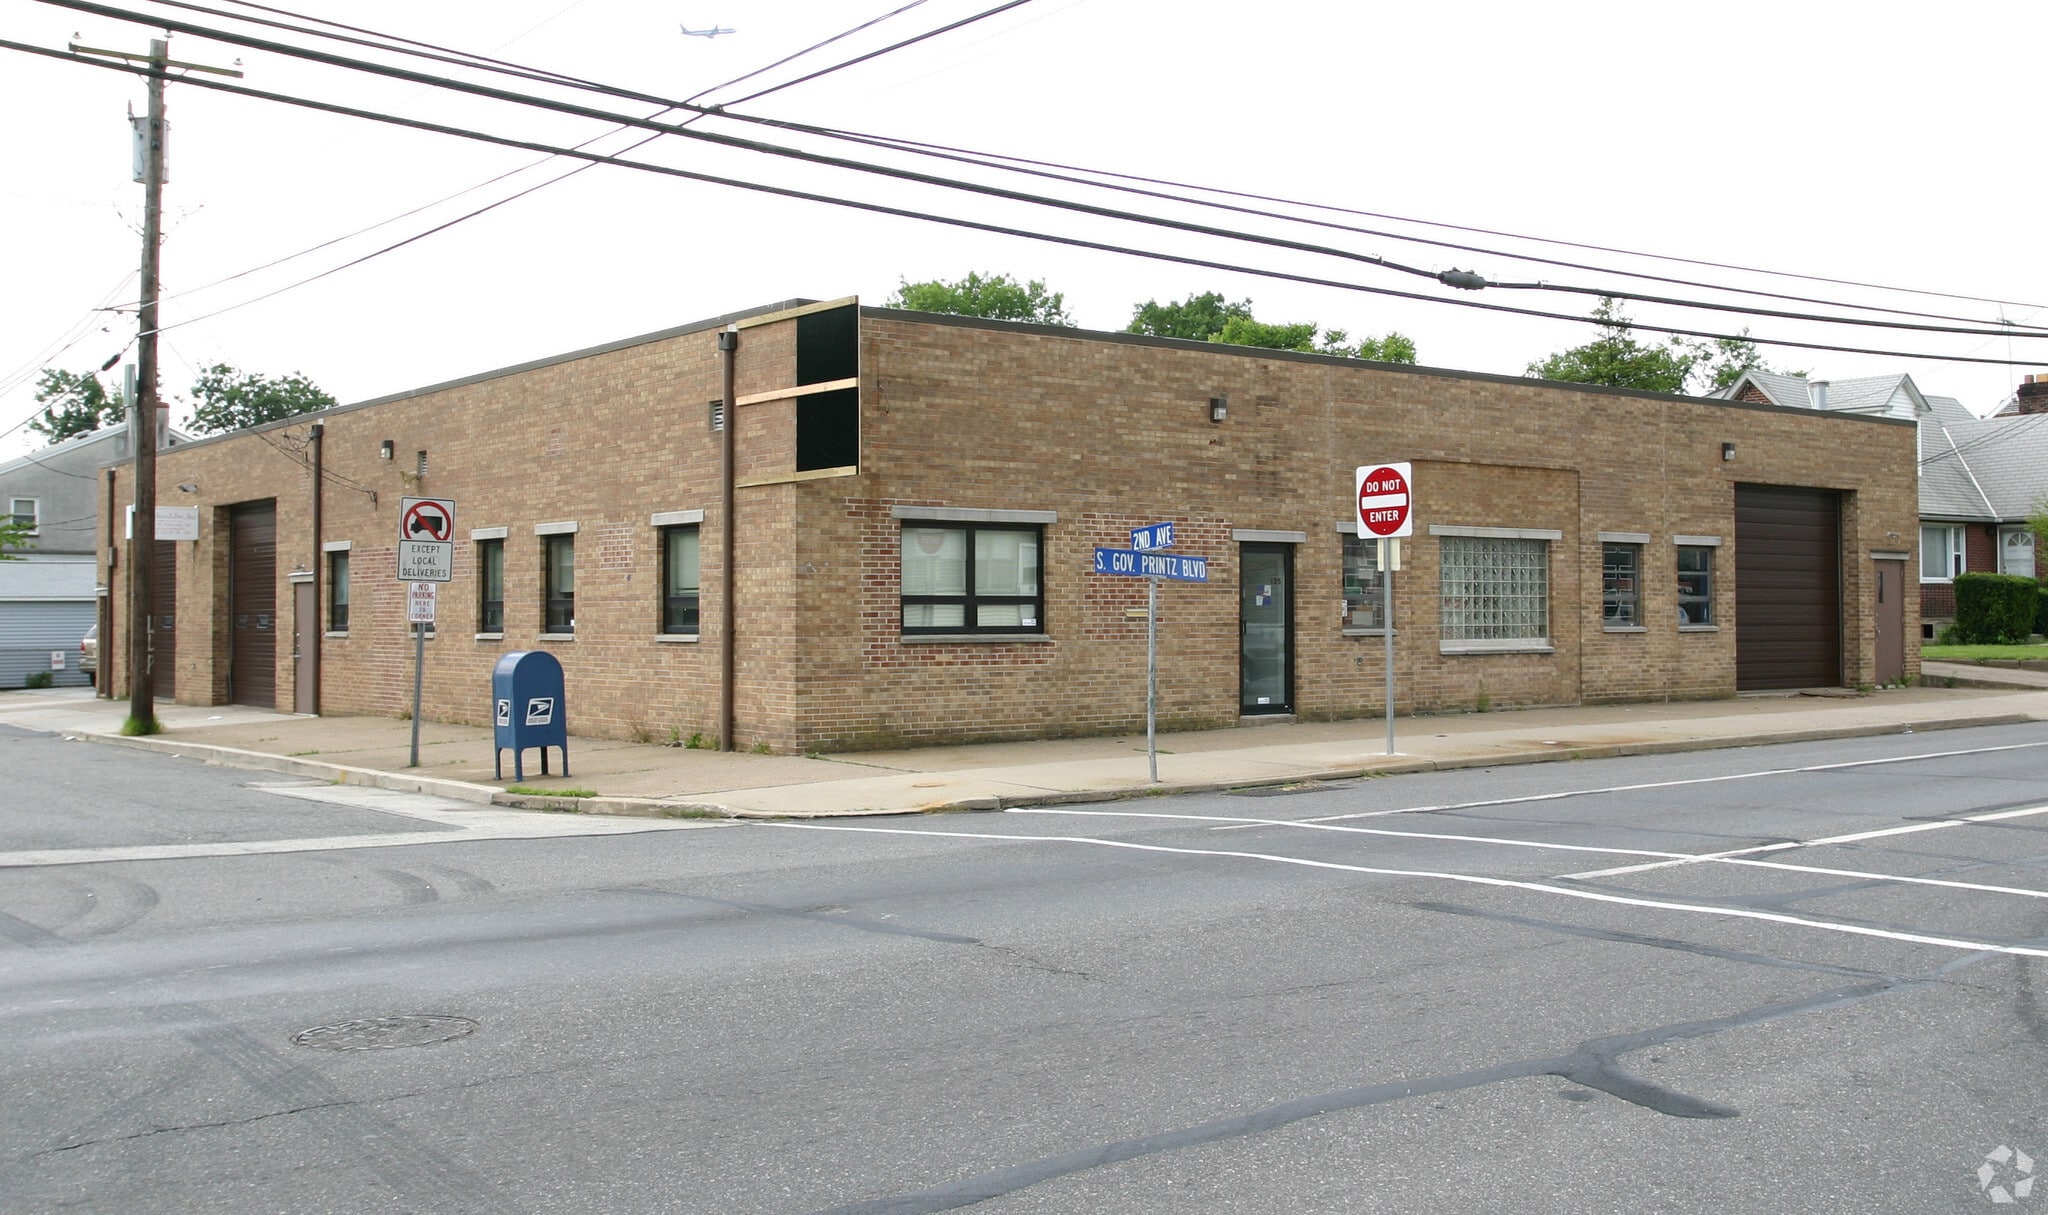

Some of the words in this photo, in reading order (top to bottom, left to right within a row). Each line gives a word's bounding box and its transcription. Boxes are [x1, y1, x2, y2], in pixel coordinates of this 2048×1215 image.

[1366, 481, 1379, 493] DO
[1382, 479, 1401, 491] NOT
[1370, 510, 1399, 523] ENTER
[1133, 531, 1150, 551] 2ND
[1156, 526, 1172, 546] AVE
[411, 545, 440, 553] EXCEPT
[412, 557, 437, 566] LOCAL
[1096, 552, 1106, 570] S.
[1113, 553, 1136, 573] GOV.
[1142, 556, 1178, 576] PRINTZ
[1182, 560, 1206, 578] BLVD
[402, 568, 447, 577] DELIVERIES
